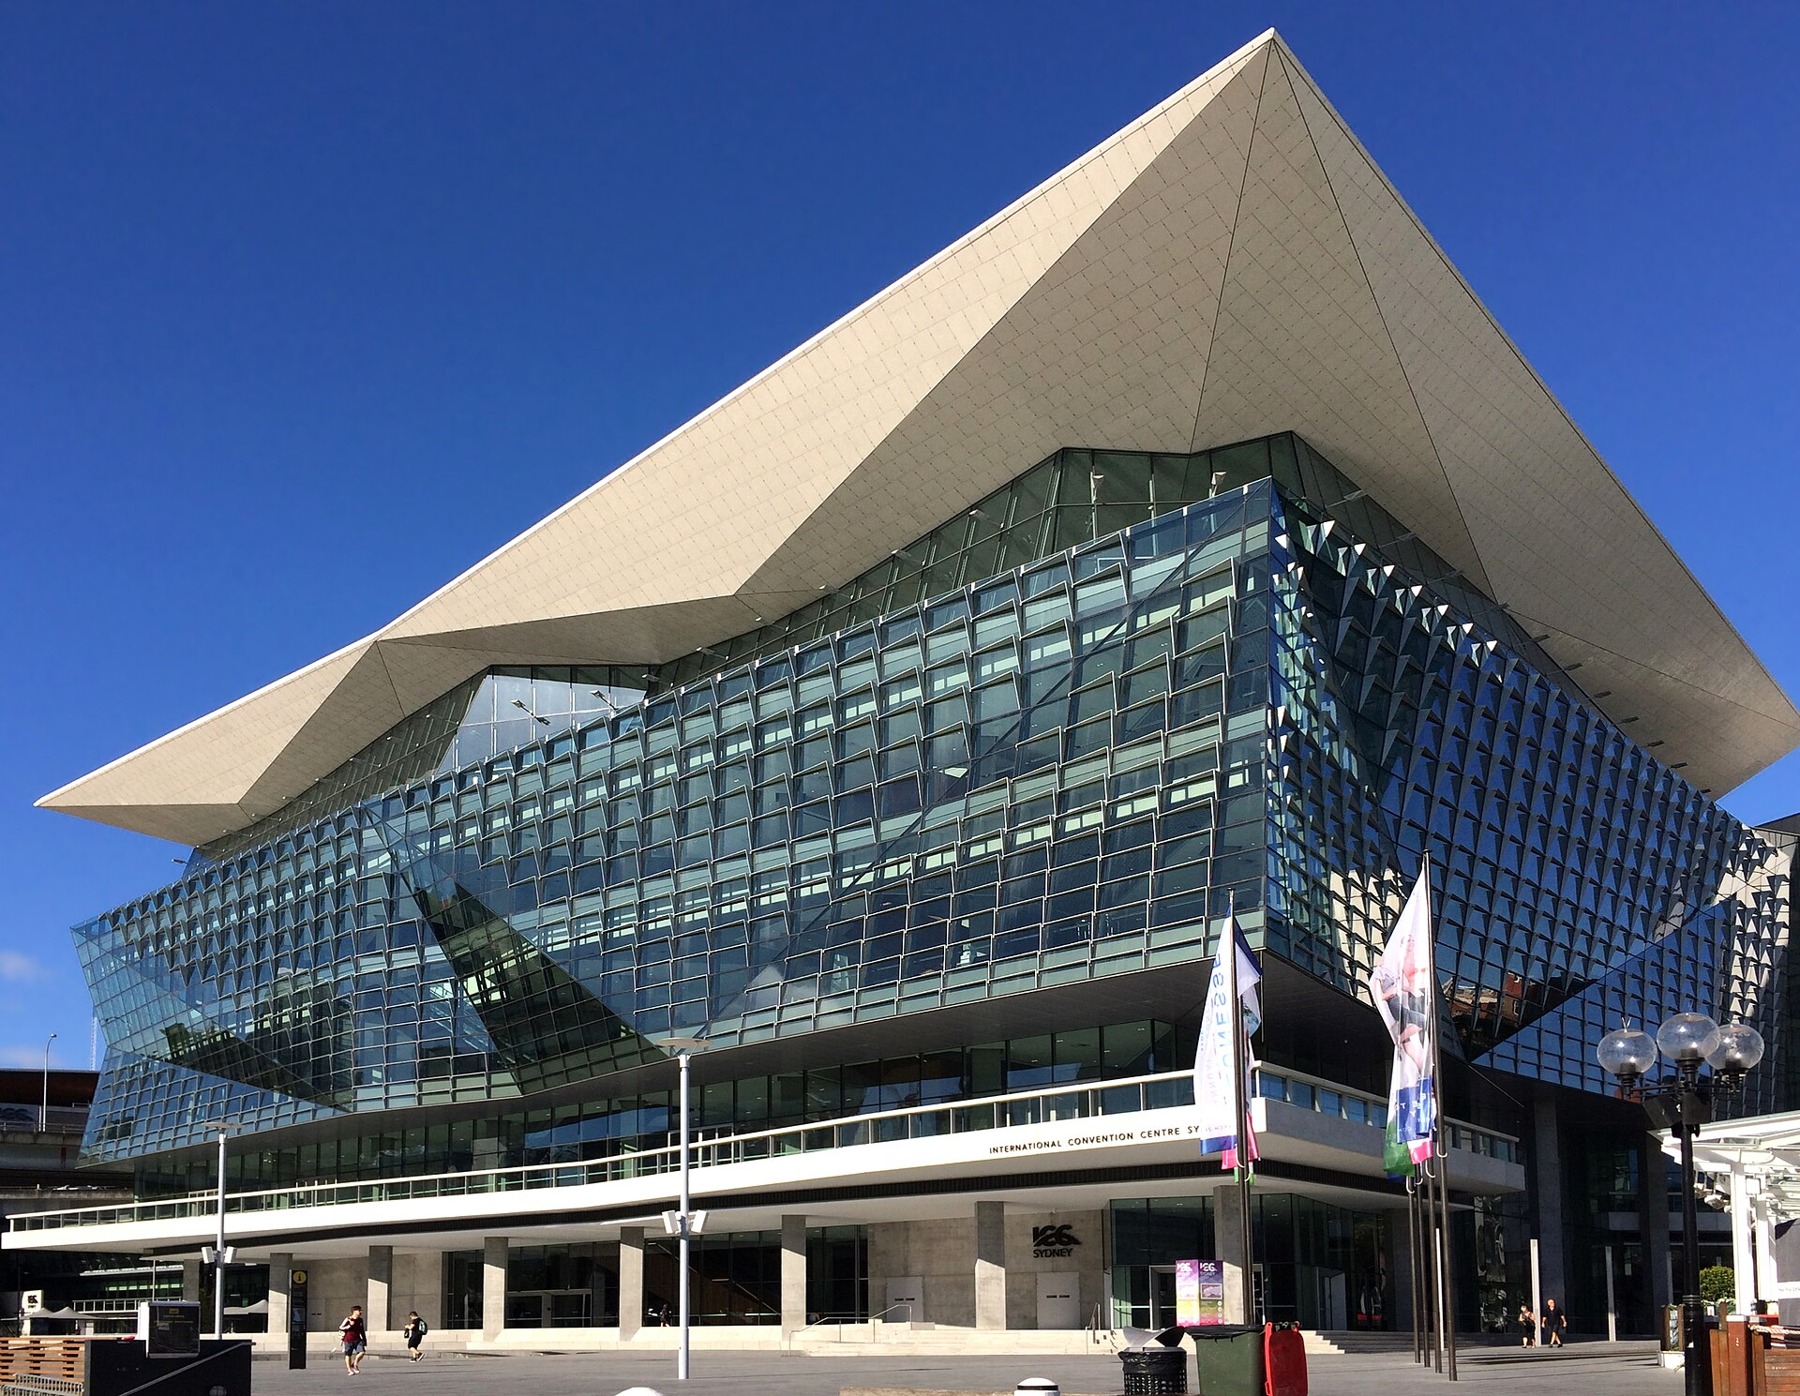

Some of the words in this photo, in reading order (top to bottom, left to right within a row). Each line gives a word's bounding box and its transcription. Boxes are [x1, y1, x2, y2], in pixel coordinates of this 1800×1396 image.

[989, 1140, 1062, 1154] INTERNATIONAL
[1067, 1132, 1134, 1146] CONVENTION
[1140, 1127, 1180, 1139] CENTRE
[1187, 1125, 1200, 1134] SY
[1033, 1248, 1074, 1259] SYDNEY
